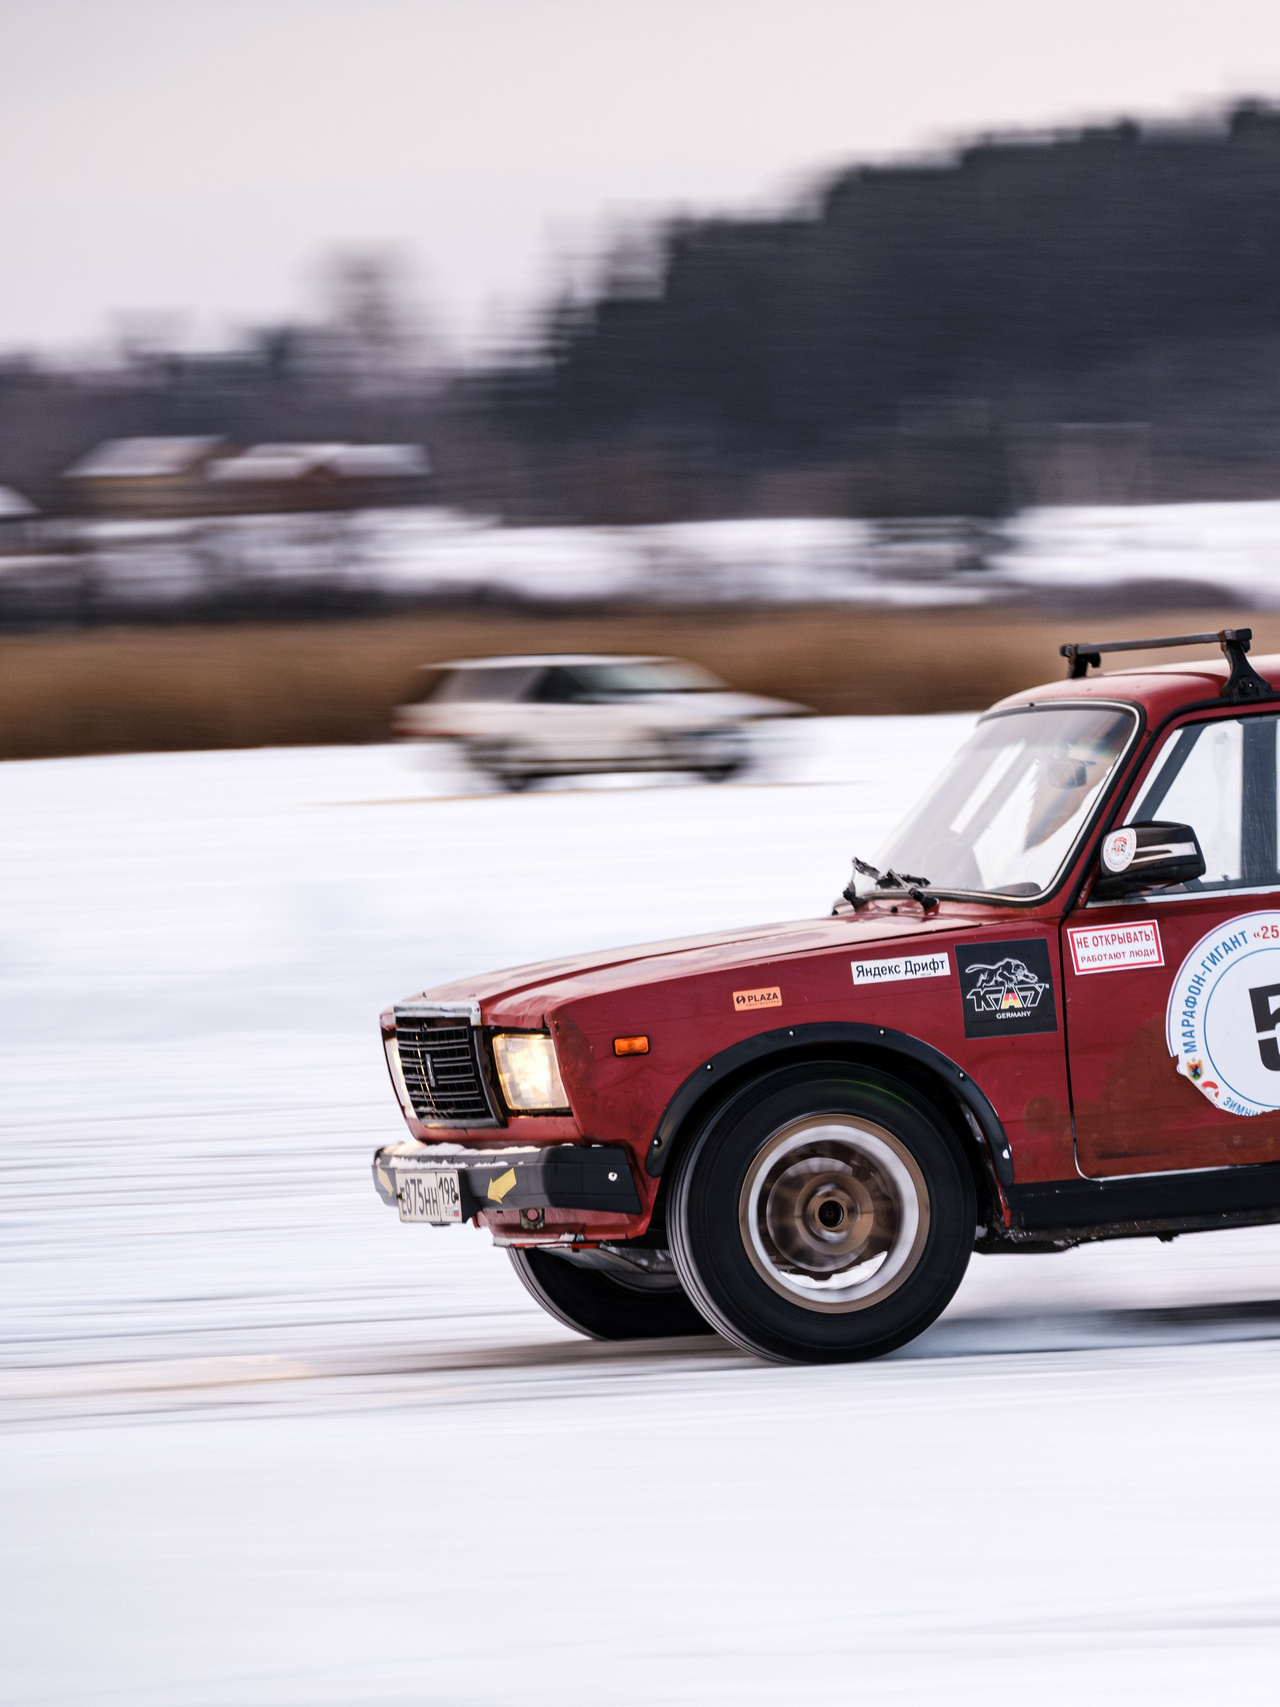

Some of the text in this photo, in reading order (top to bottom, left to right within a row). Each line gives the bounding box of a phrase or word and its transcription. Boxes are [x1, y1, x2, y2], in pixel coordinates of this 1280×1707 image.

[1076, 929, 1155, 950] НЕ ОТКРЫВАТЬ!
[1080, 948, 1156, 964] РАБОТАЮТ ЛЮДИ
[855, 958, 946, 979] Яндекс Дрифт
[747, 992, 779, 1003] PLAZA
[1181, 930, 1249, 1054] МАРАФОН-ГИГАНТ
[996, 1010, 1032, 1020] GERMANY
[1223, 1096, 1266, 1117] ЗИМН
[439, 1176, 458, 1205] 198
